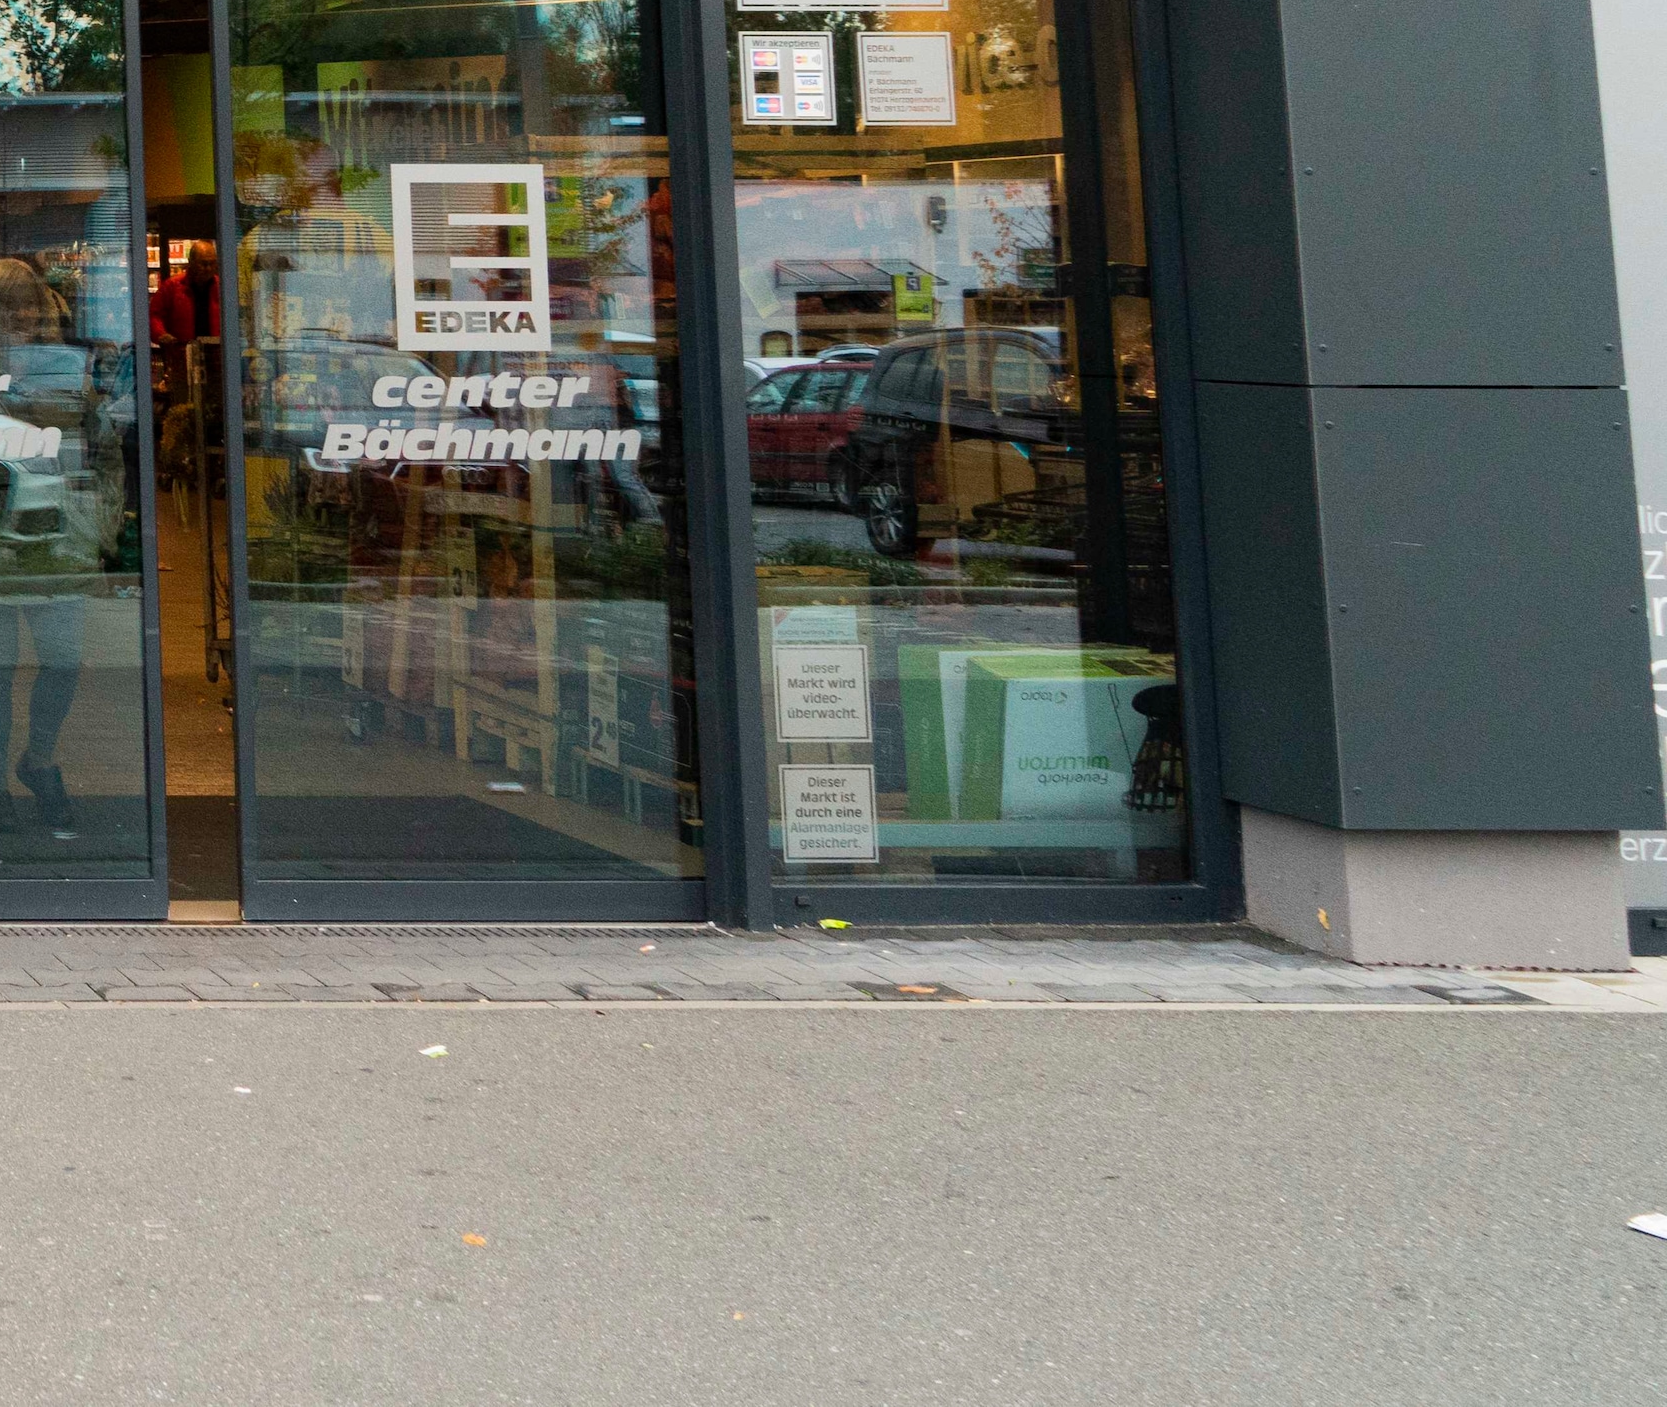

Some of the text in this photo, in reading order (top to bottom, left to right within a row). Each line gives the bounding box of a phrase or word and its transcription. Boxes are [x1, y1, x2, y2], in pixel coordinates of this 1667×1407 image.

[414, 311, 537, 333] EDEKA
[372, 371, 590, 408] center
[321, 419, 642, 460] Bächmann
[801, 663, 841, 674] Dieser
[787, 677, 856, 689] Markt wird
[803, 692, 842, 704] video-
[787, 708, 860, 720] überwacht.
[807, 776, 847, 788] Dieser
[800, 791, 856, 803] Markt ist
[795, 807, 862, 819] durch eine
[790, 822, 869, 835] Alarmanlage
[799, 837, 862, 850] gesichert.
